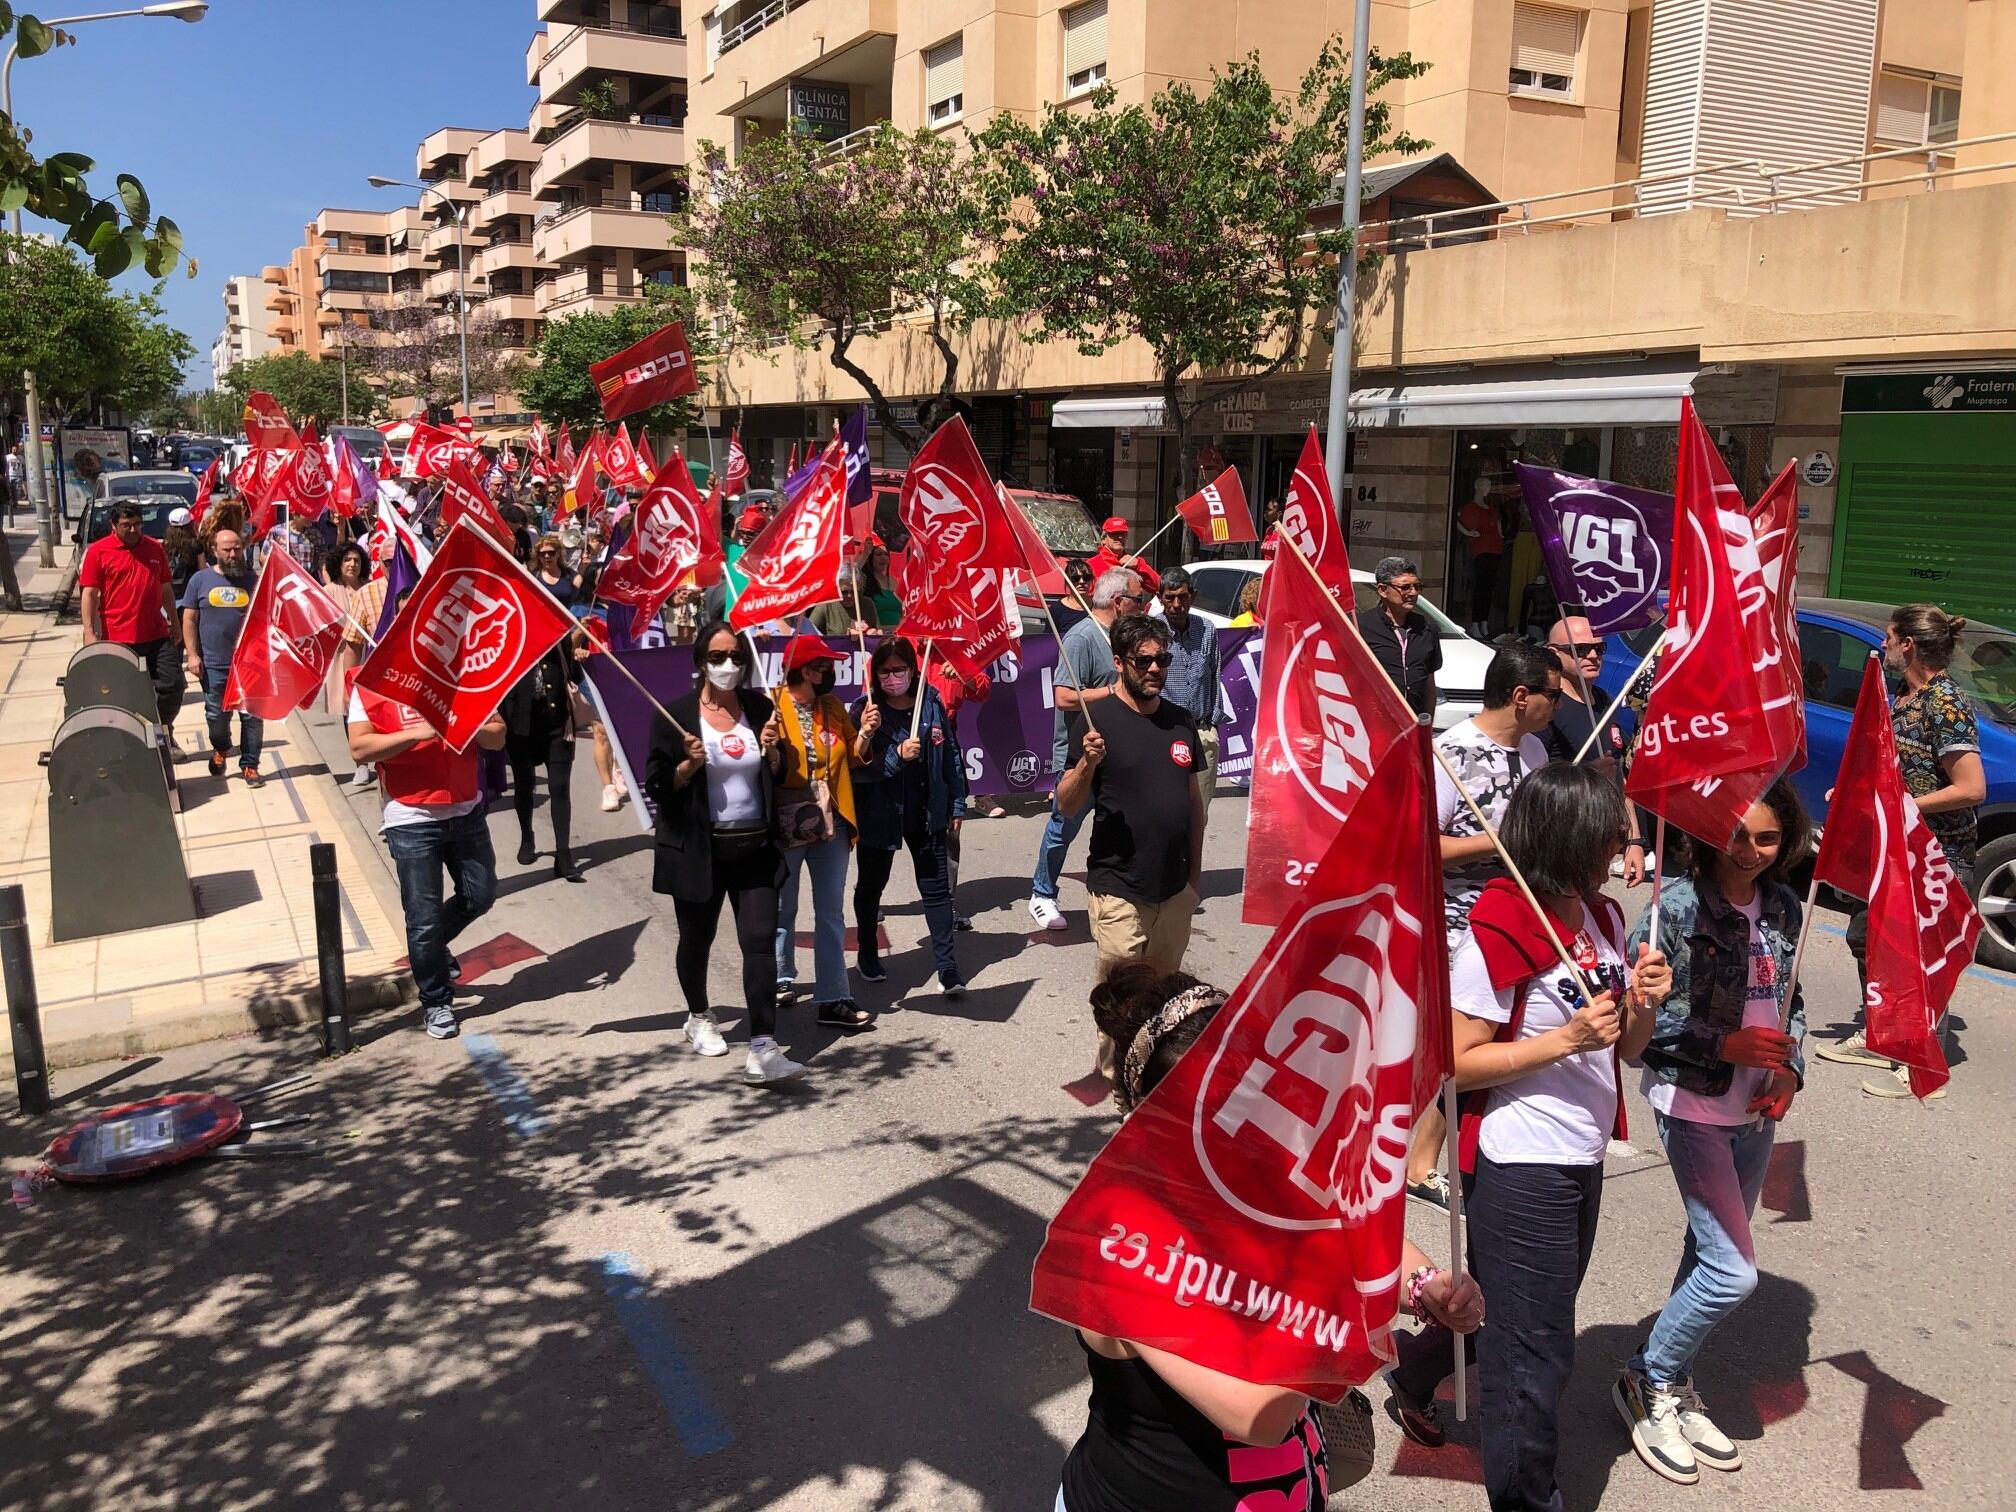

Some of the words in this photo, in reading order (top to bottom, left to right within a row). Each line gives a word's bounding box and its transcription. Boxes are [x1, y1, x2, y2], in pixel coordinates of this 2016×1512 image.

[797, 89, 847, 106] CLÍNICA
[797, 104, 846, 120] DENTAL
[1968, 379, 2016, 392] Fratern
[1214, 391, 1267, 412] TERANGA
[1967, 397, 2008, 406] Muprespa
[1222, 413, 1254, 432] KIDS
[1357, 485, 1377, 502] 84
[417, 575, 497, 662] UGT
[1173, 744, 1191, 757] UGT
[1011, 756, 1037, 771] UGT
[1217, 755, 1253, 776] SUMAN
